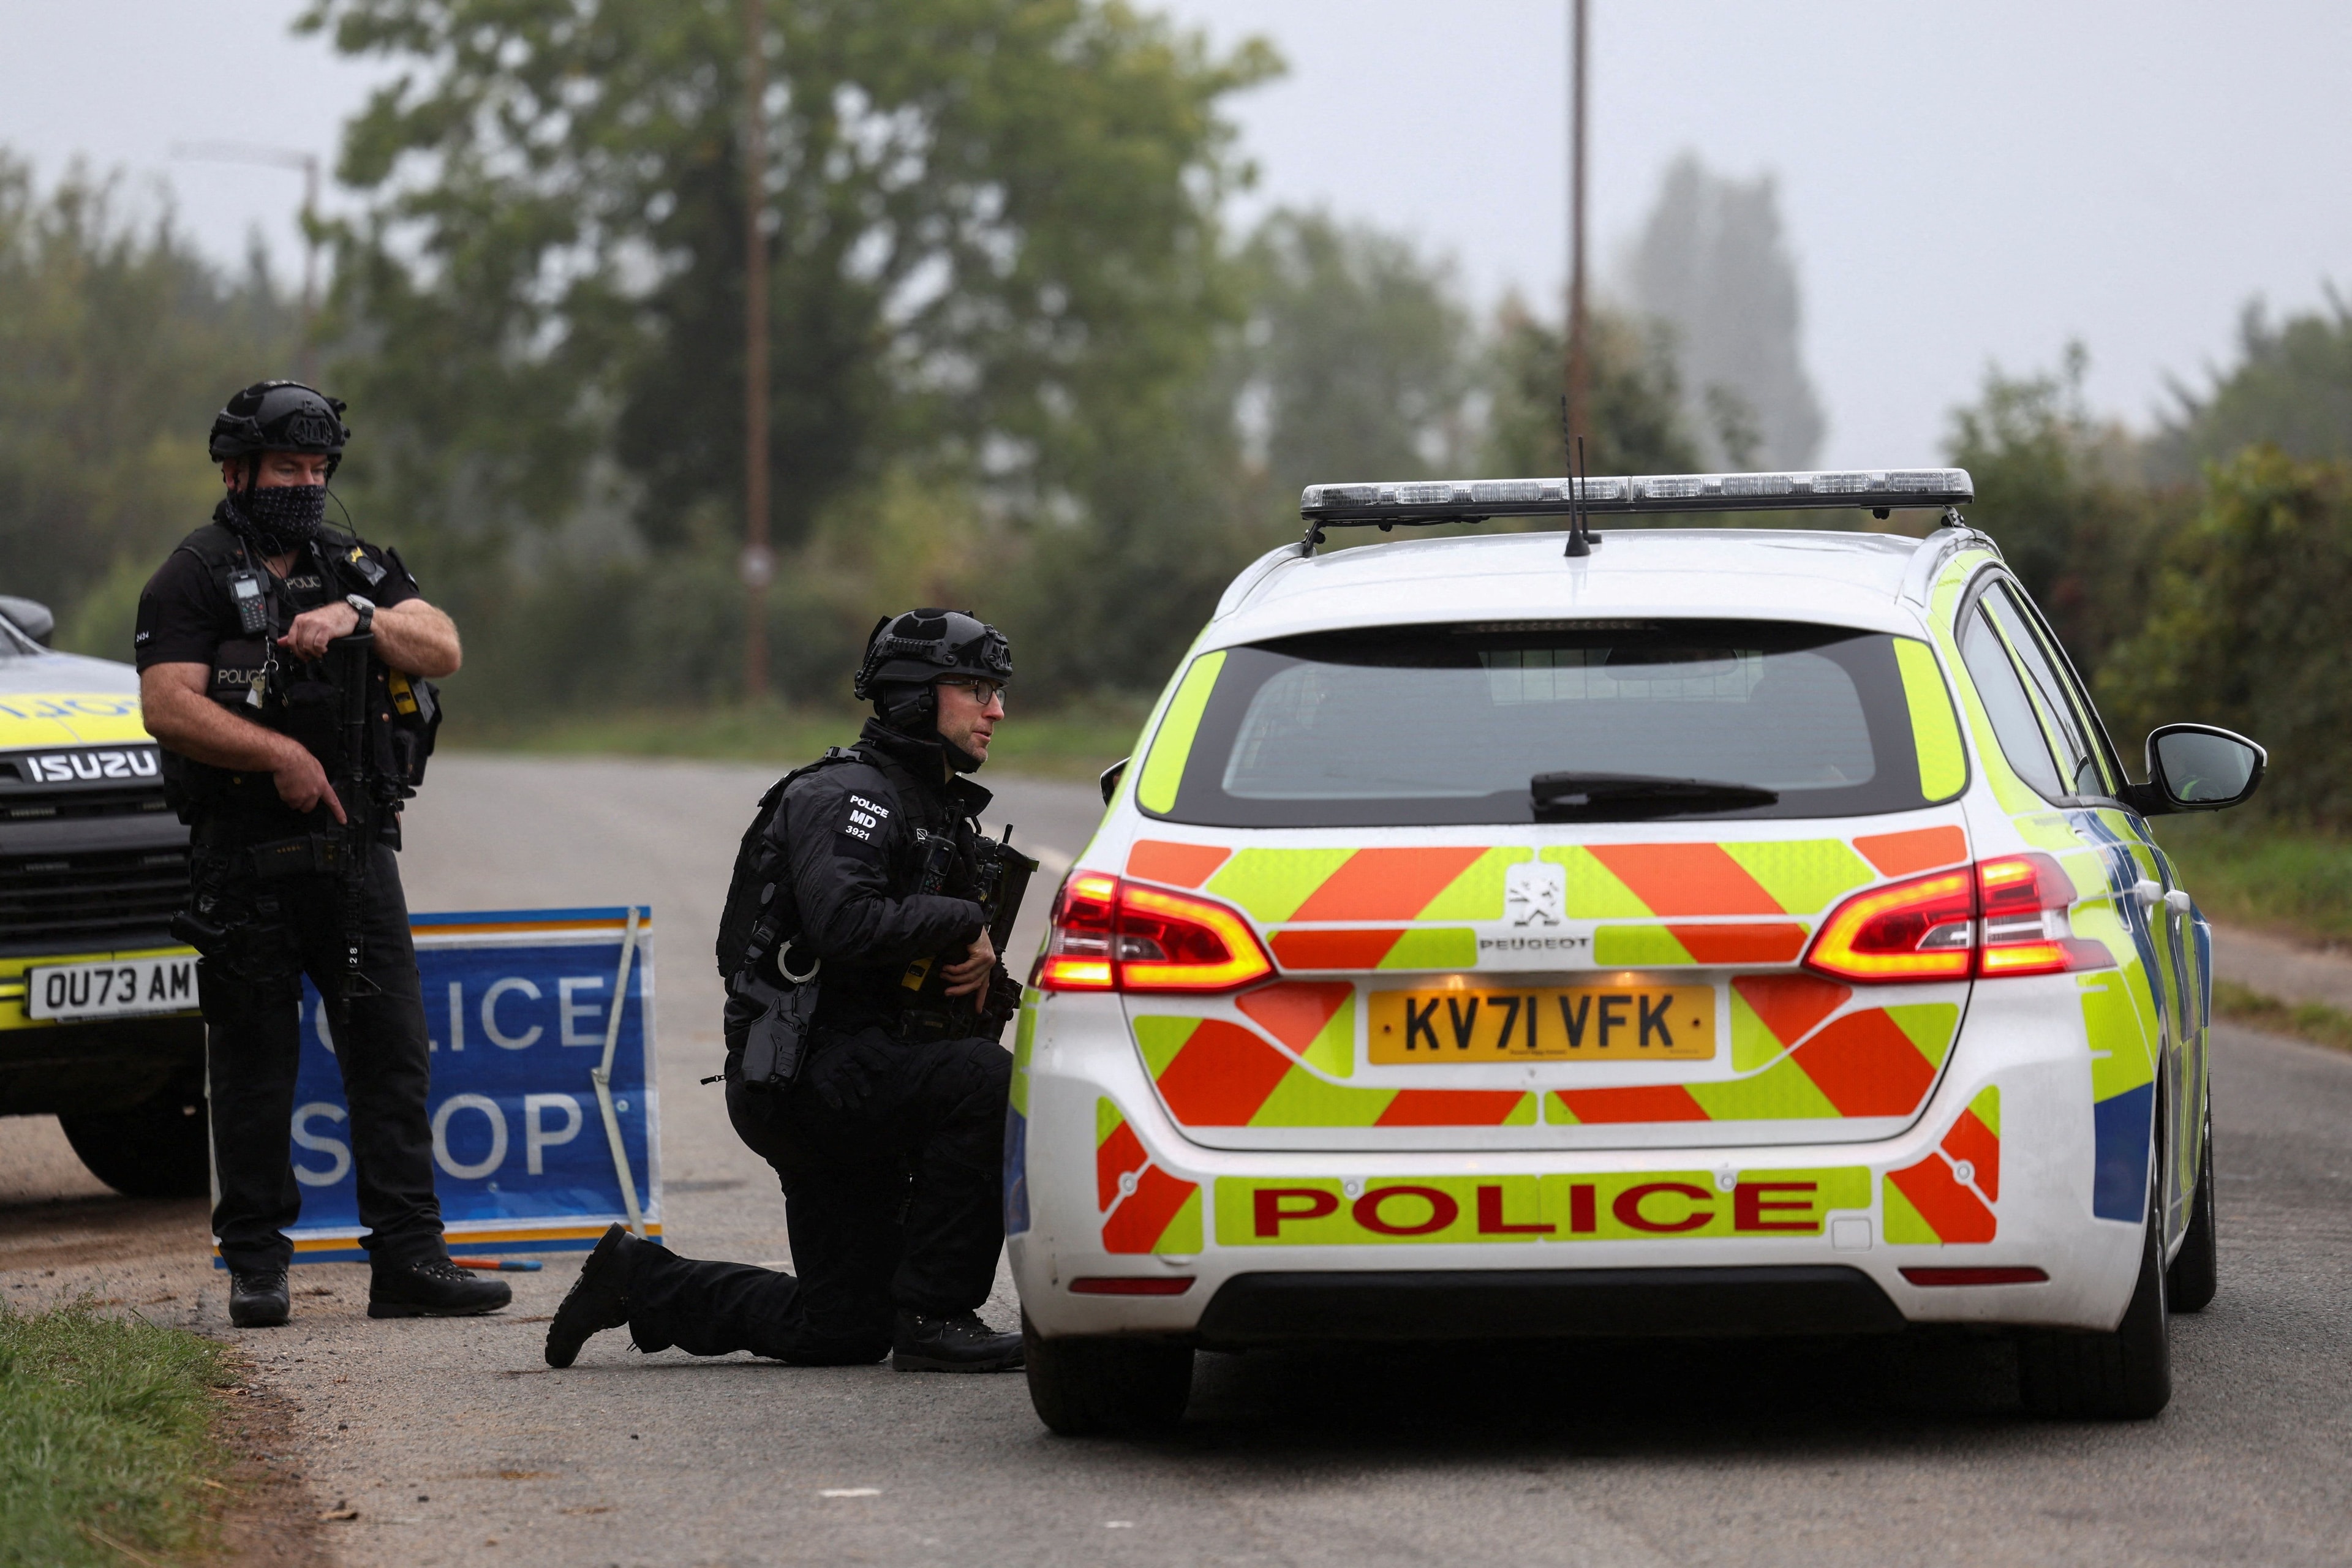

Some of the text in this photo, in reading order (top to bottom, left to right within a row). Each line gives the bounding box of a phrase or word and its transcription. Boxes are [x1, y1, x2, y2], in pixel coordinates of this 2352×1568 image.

[284, 575, 322, 590] POLIC
[27, 750, 157, 783] ISUZU
[849, 809, 876, 829] MD
[850, 795, 889, 818] POLICE
[845, 825, 870, 840] 3921
[1480, 938, 1590, 950] PEUGEOT
[45, 962, 200, 1009] OU73 AM
[1406, 994, 1675, 1050] KV71 VFK
[291, 1093, 583, 1187] SOP
[1253, 1182, 1819, 1237] POLICE
